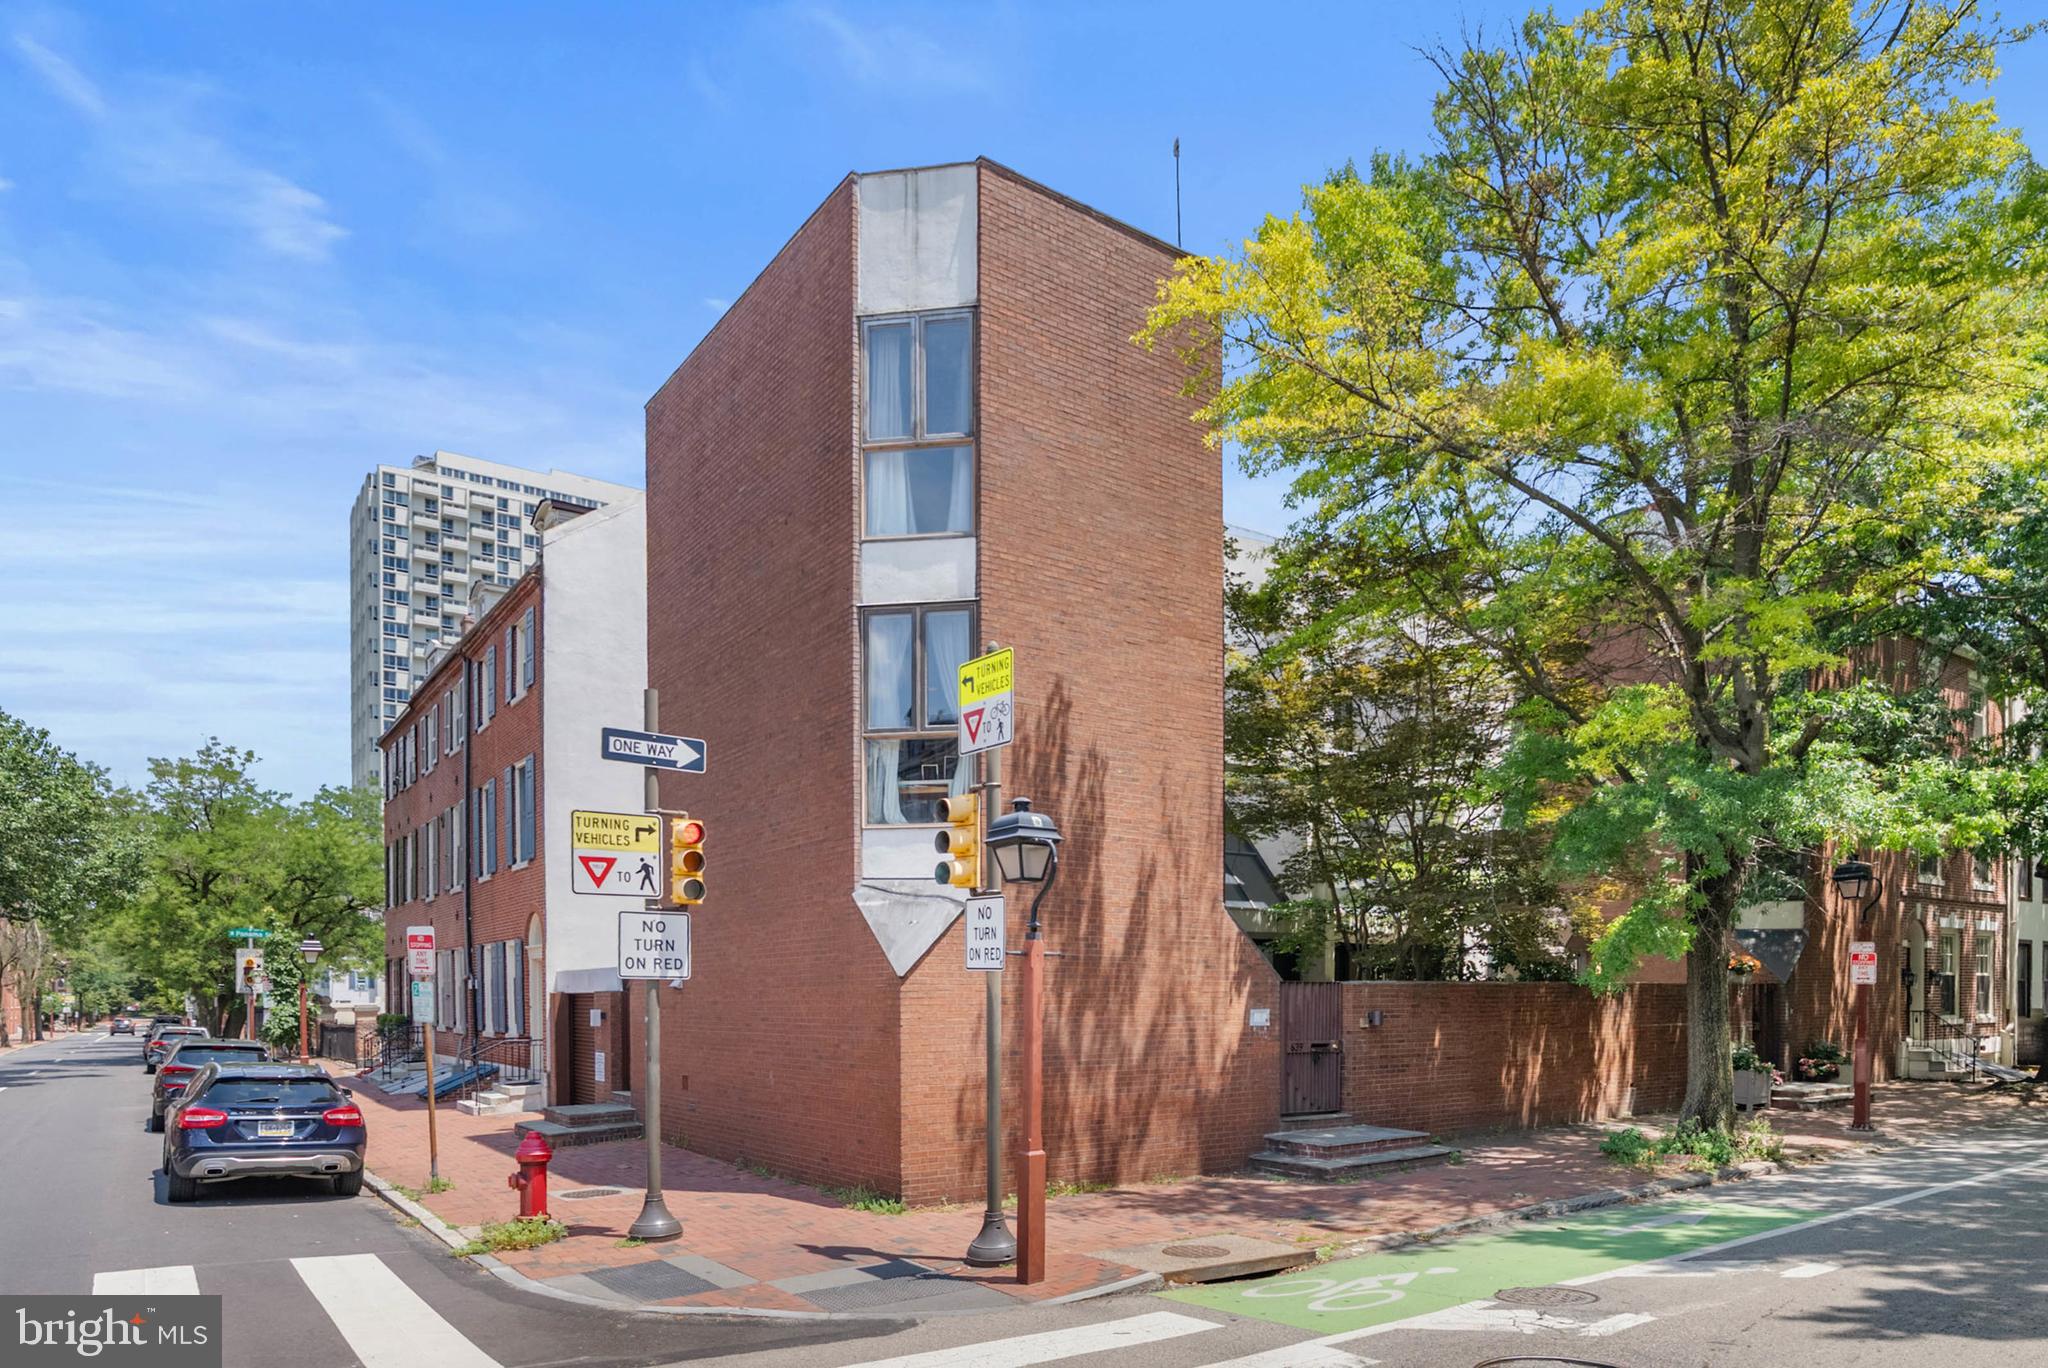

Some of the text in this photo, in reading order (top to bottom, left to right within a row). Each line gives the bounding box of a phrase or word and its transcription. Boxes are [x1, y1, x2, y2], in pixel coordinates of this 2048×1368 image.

[976, 657, 1009, 679] TURNING
[976, 675, 1010, 695] VEHICLES
[982, 720, 992, 734] TO
[613, 739, 675, 758] ONE WAY
[576, 816, 630, 831] TURNING
[575, 832, 631, 847] VEHICLES
[617, 871, 631, 883] TO
[978, 906, 992, 920] NO
[642, 920, 666, 933] NO
[974, 927, 997, 941] TURN
[633, 938, 675, 952] TURN
[969, 947, 1002, 961] ON RED
[625, 957, 683, 971] ON RED
